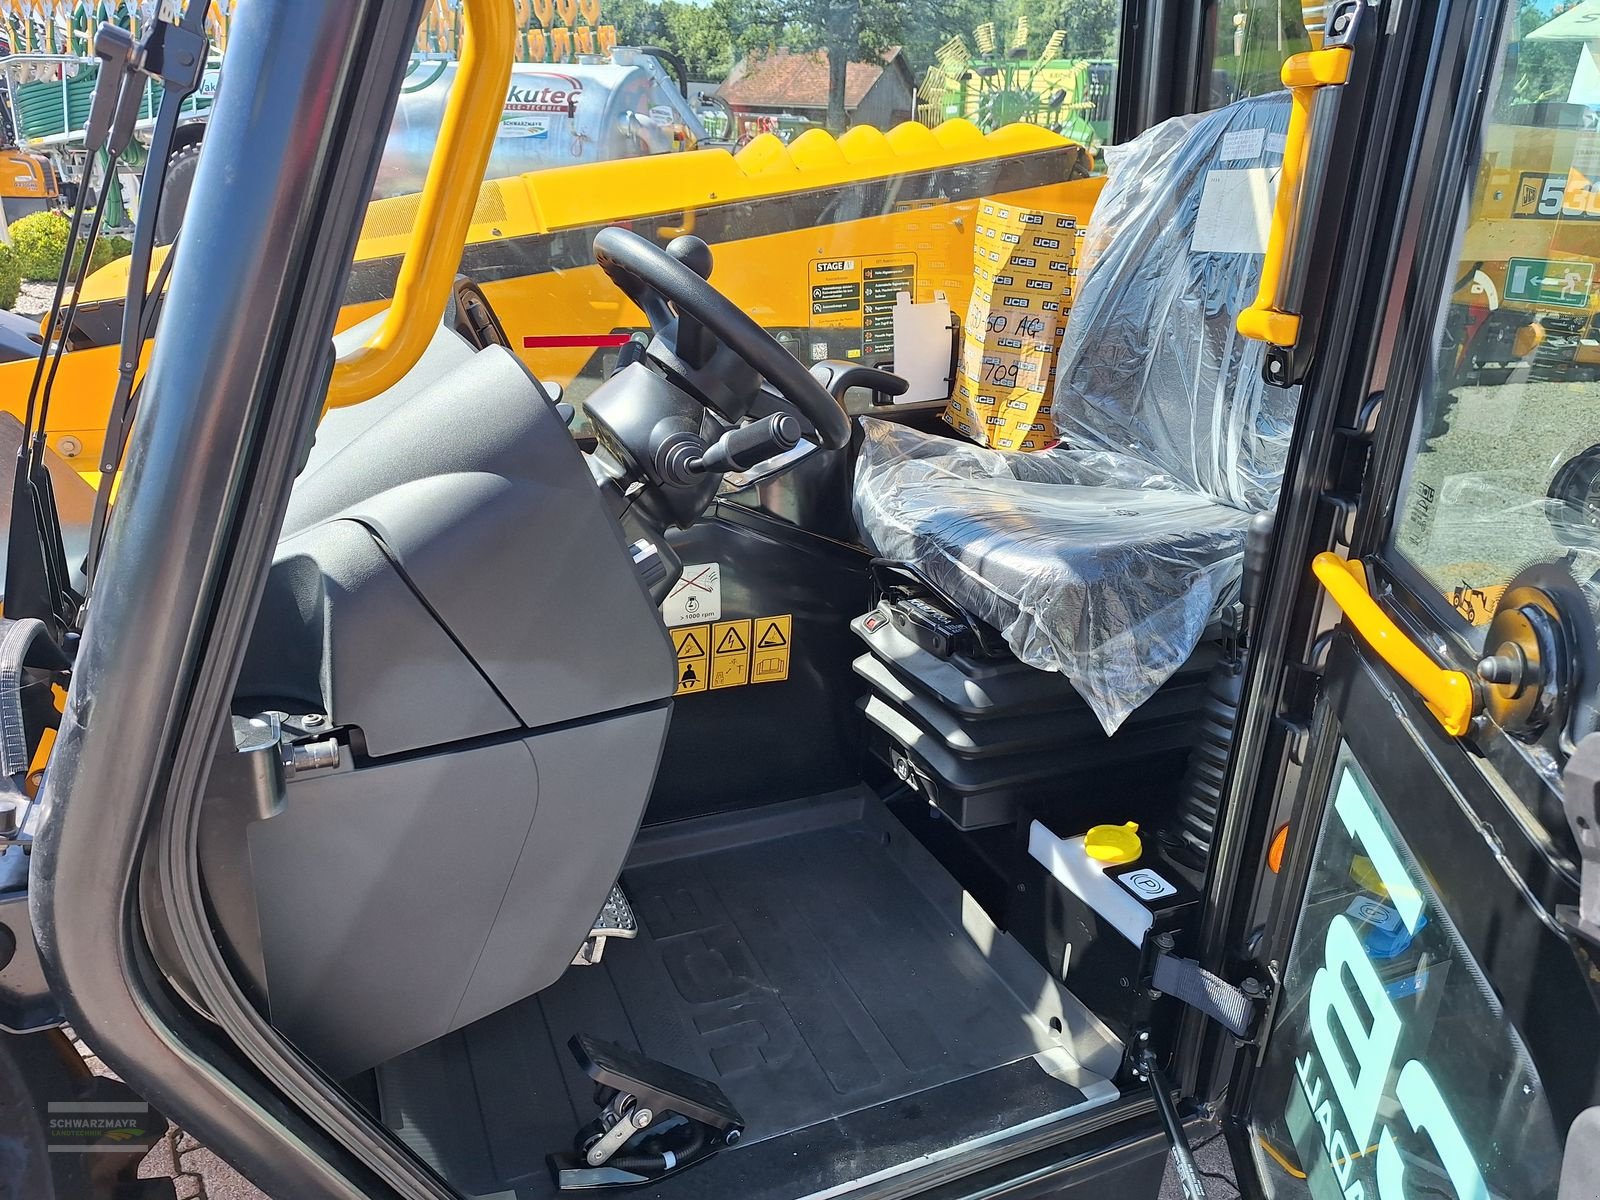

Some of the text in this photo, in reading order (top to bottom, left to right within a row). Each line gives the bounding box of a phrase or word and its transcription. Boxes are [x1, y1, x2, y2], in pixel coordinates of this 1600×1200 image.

[1020, 214, 1042, 223] JCB
[1058, 220, 1076, 228] JC
[1002, 233, 1019, 243] JCB
[1034, 238, 1058, 248] JCB
[817, 261, 843, 271] STAGE
[1012, 257, 1035, 266] JCB
[1050, 262, 1068, 271] JC
[1027, 280, 1051, 289] JCB
[1005, 297, 1028, 307] JCB
[999, 339, 1021, 348] JCB
[1008, 401, 1027, 409] JCB
[988, 417, 1005, 425] JCB
